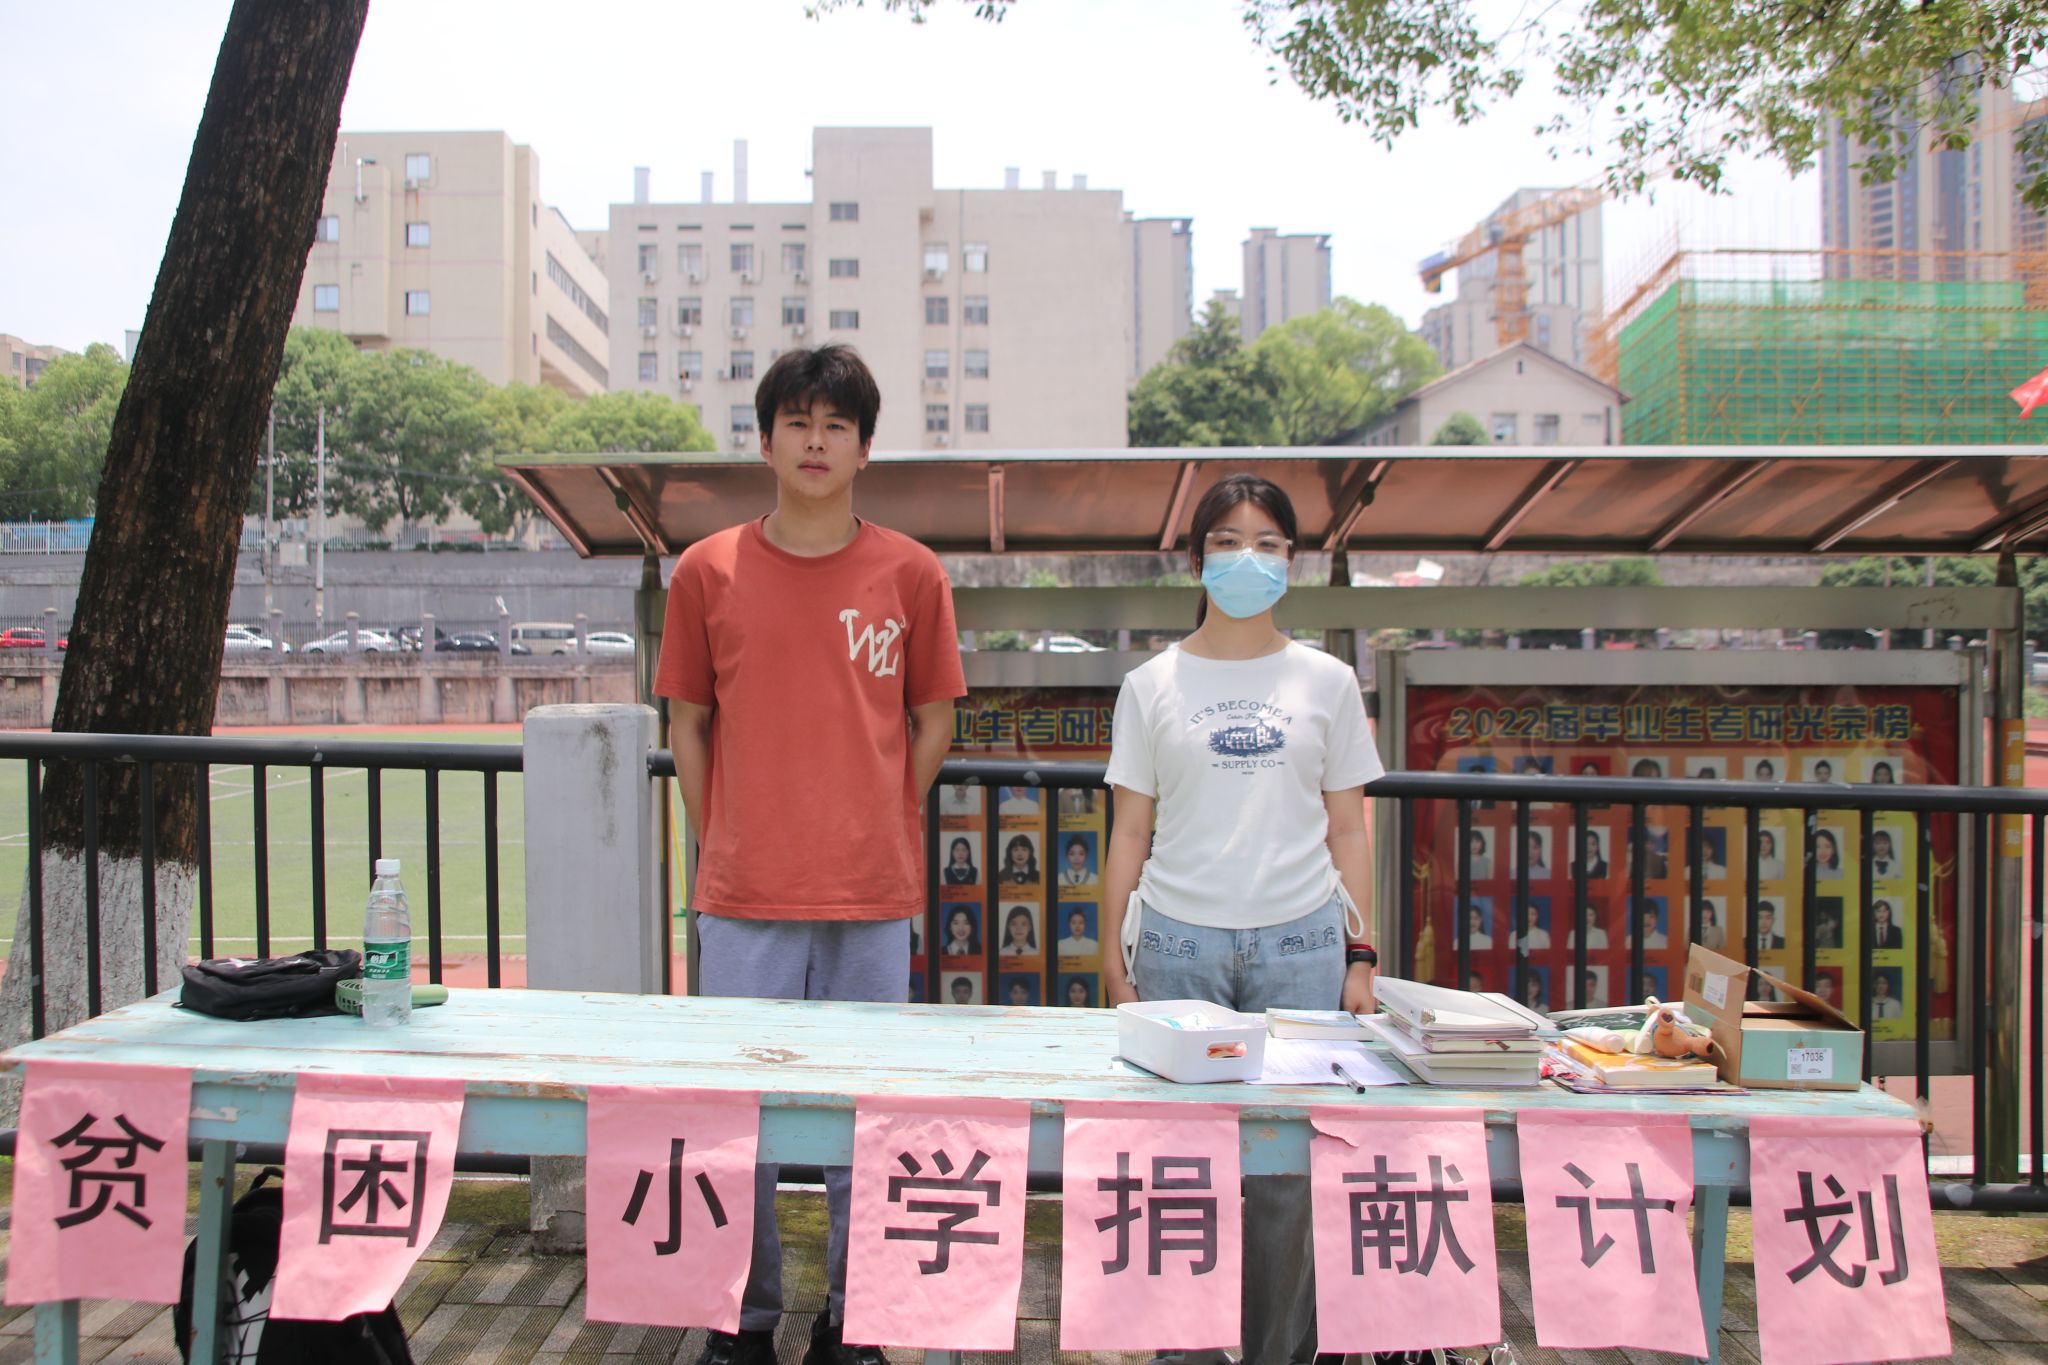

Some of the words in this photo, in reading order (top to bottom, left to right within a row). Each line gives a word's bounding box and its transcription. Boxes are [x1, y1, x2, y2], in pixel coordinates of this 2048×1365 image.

[1190, 706, 1215, 725] IT'S
[1217, 700, 1283, 718] BECOME
[1450, 704, 1910, 742] 2022届毕业生考研光荣榜
[1221, 760, 1258, 769] SUPPLY
[1801, 1052, 1825, 1062] 17036
[50, 1113, 165, 1230] 贫
[319, 1129, 432, 1248] 困
[622, 1138, 728, 1256] 小
[885, 1150, 1000, 1274] 学
[1095, 1152, 1217, 1276] 捐
[1342, 1155, 1476, 1277] 献
[1556, 1163, 1675, 1274] 计
[1784, 1171, 1909, 1288] 划
